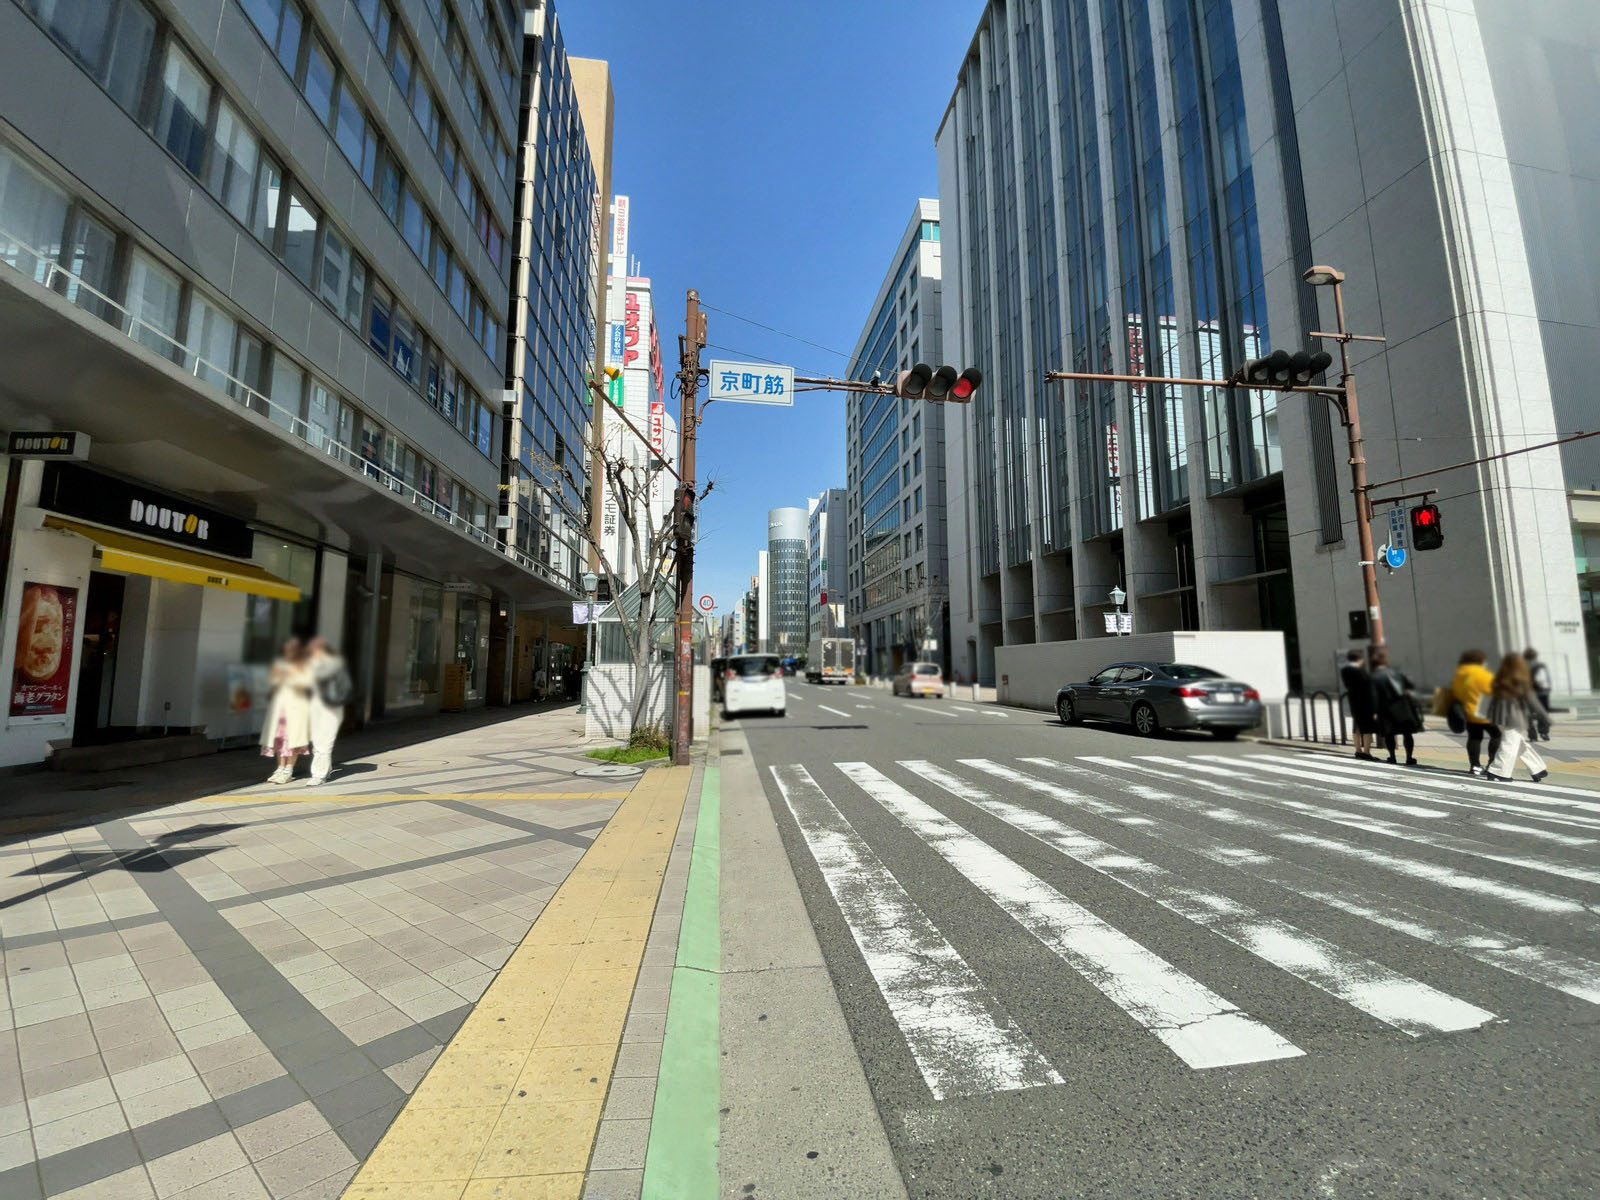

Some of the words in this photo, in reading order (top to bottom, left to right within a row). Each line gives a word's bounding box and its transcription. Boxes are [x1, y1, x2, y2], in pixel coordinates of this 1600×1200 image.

[719, 370, 785, 396] 京町筋
[15, 437, 69, 450] DOUTOR
[130, 499, 209, 540] DOUTOR
[14, 691, 66, 704] 海老グラタン
